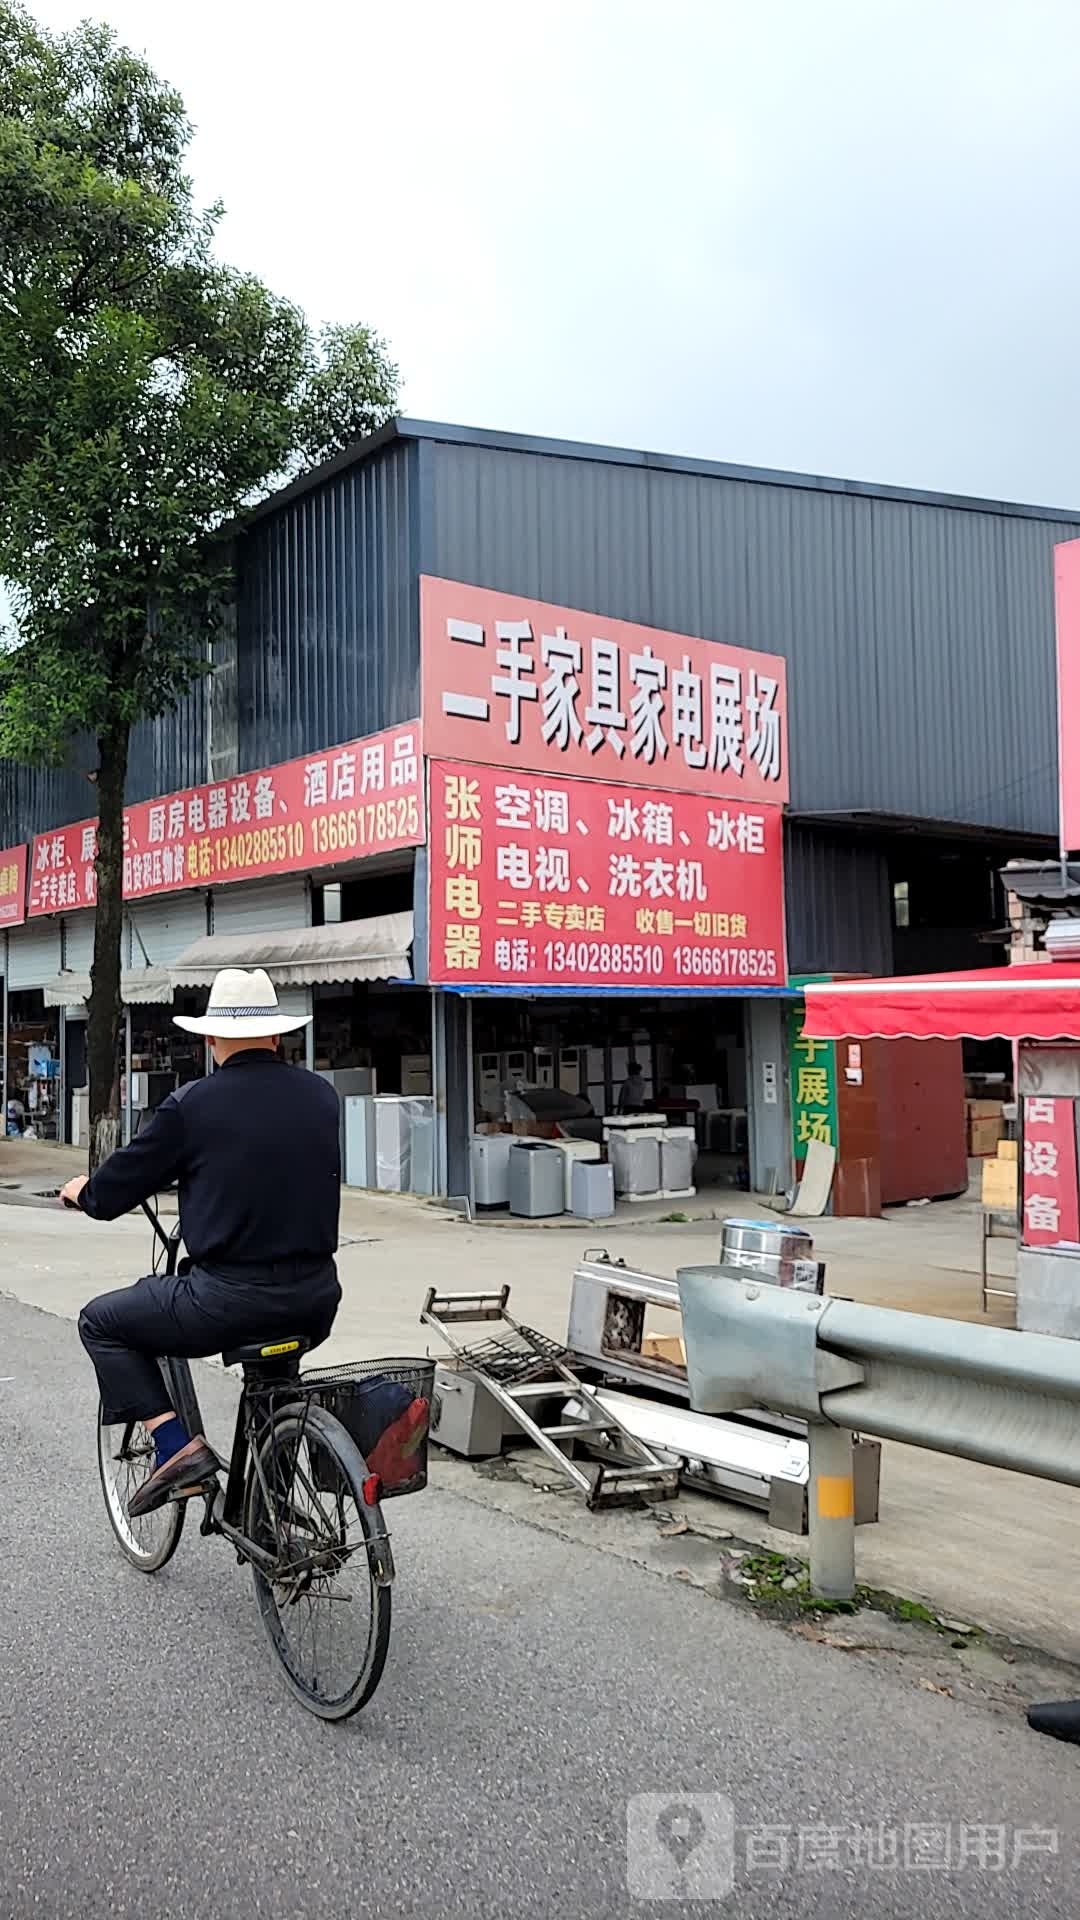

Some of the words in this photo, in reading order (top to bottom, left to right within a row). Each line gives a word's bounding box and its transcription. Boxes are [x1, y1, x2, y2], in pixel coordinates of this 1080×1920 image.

[441, 617, 784, 782] 二手家具家电展场
[311, 794, 419, 853] 13666178525
[444, 776, 482, 970] 张师电器
[496, 842, 708, 901] 电视、洗衣机
[496, 900, 606, 932] 二手专卖店
[635, 907, 748, 938] 收售一切旧货
[543, 940, 664, 975] 13402885510
[672, 945, 777, 977] 13666178525
